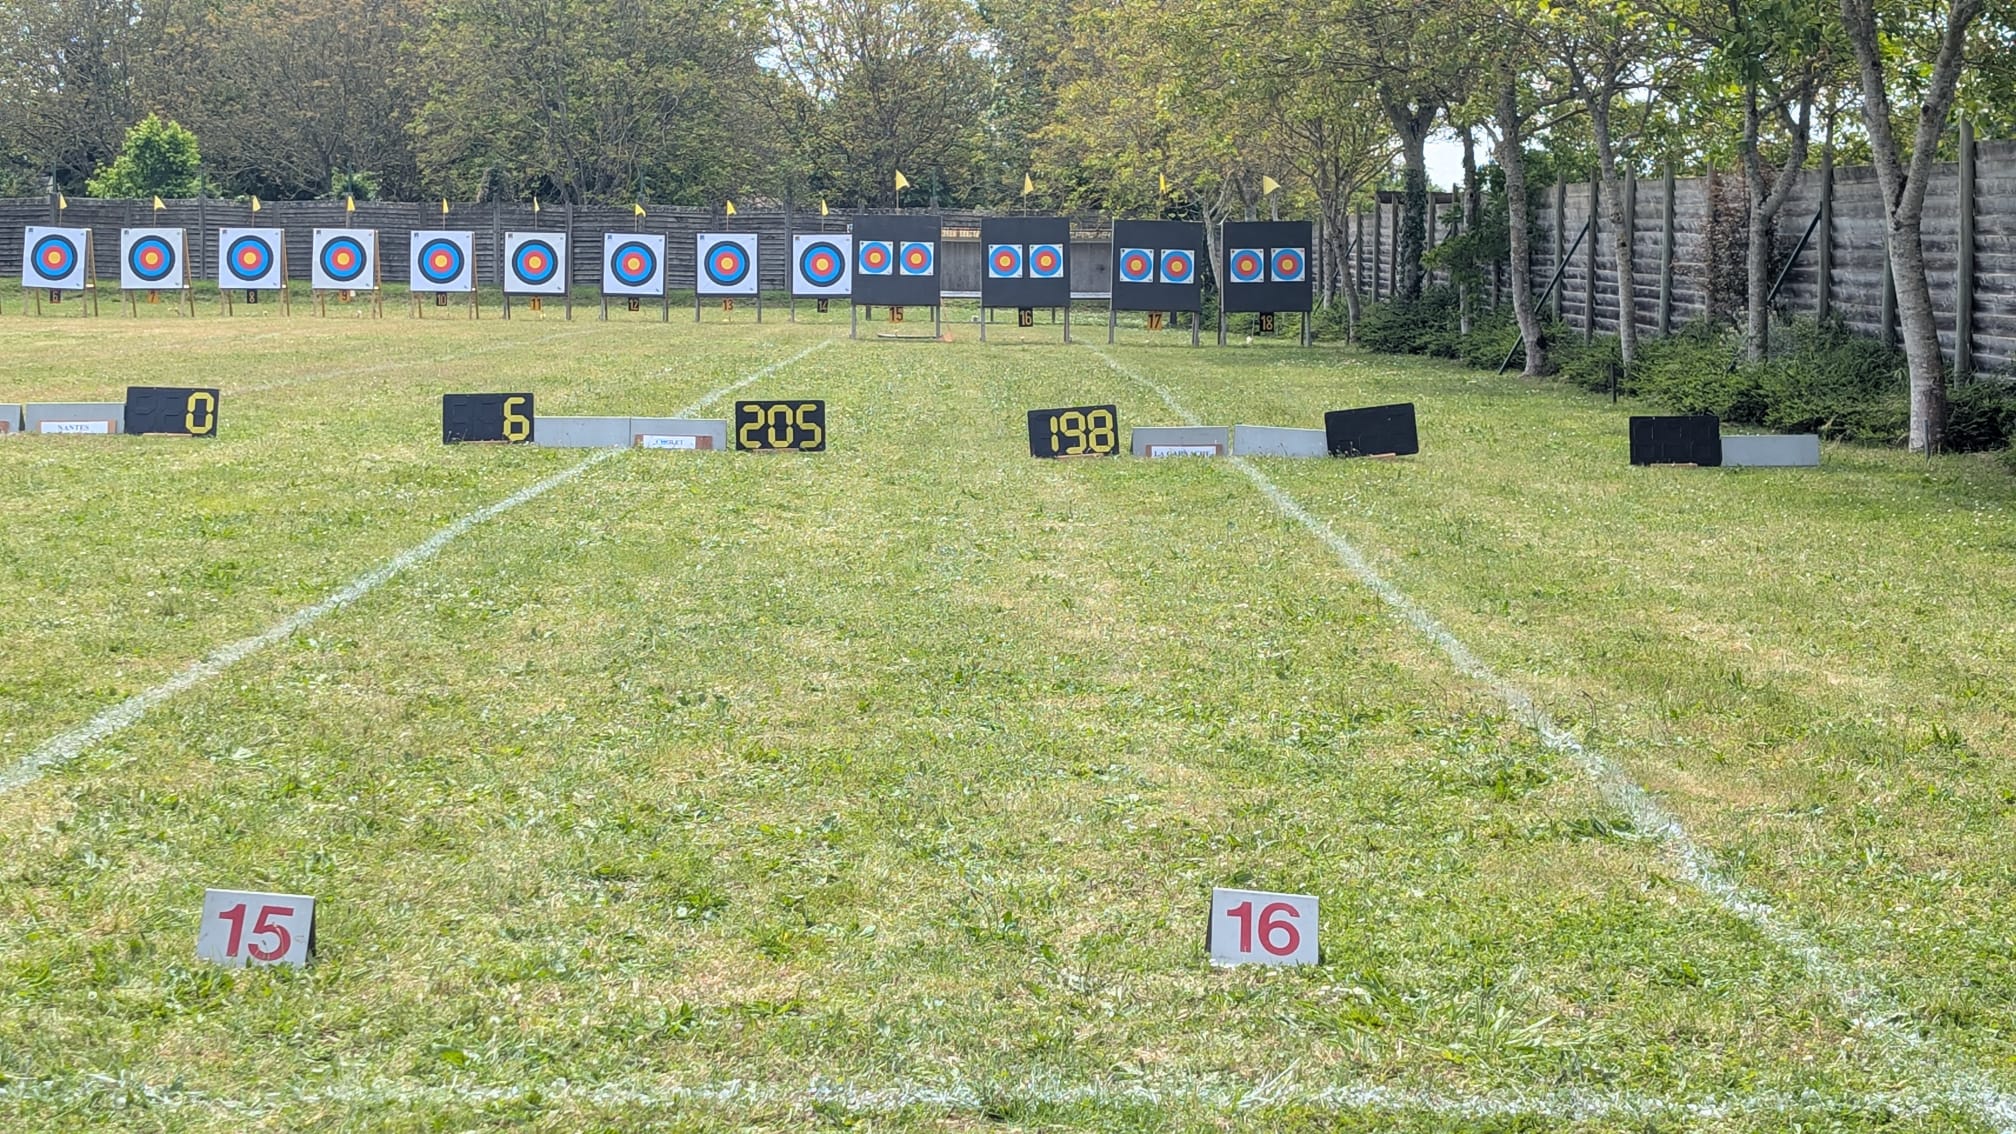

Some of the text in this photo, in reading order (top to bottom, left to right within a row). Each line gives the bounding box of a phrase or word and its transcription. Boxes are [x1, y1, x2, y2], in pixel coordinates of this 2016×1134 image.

[249, 291, 255, 303] 8
[437, 295, 447, 305] 10
[532, 298, 541, 310] 11
[629, 299, 639, 310] 12
[723, 299, 734, 311] 13
[818, 300, 828, 311] 14
[890, 306, 904, 321] 15
[1020, 310, 1031, 326] 16
[1149, 313, 1162, 329] 17
[1260, 315, 1273, 331] 18
[185, 392, 215, 434] 0
[502, 396, 530, 441] 6
[739, 403, 822, 449] 205
[1050, 409, 1114, 454] 198
[218, 903, 295, 962] 15
[1226, 901, 1301, 957] 16
